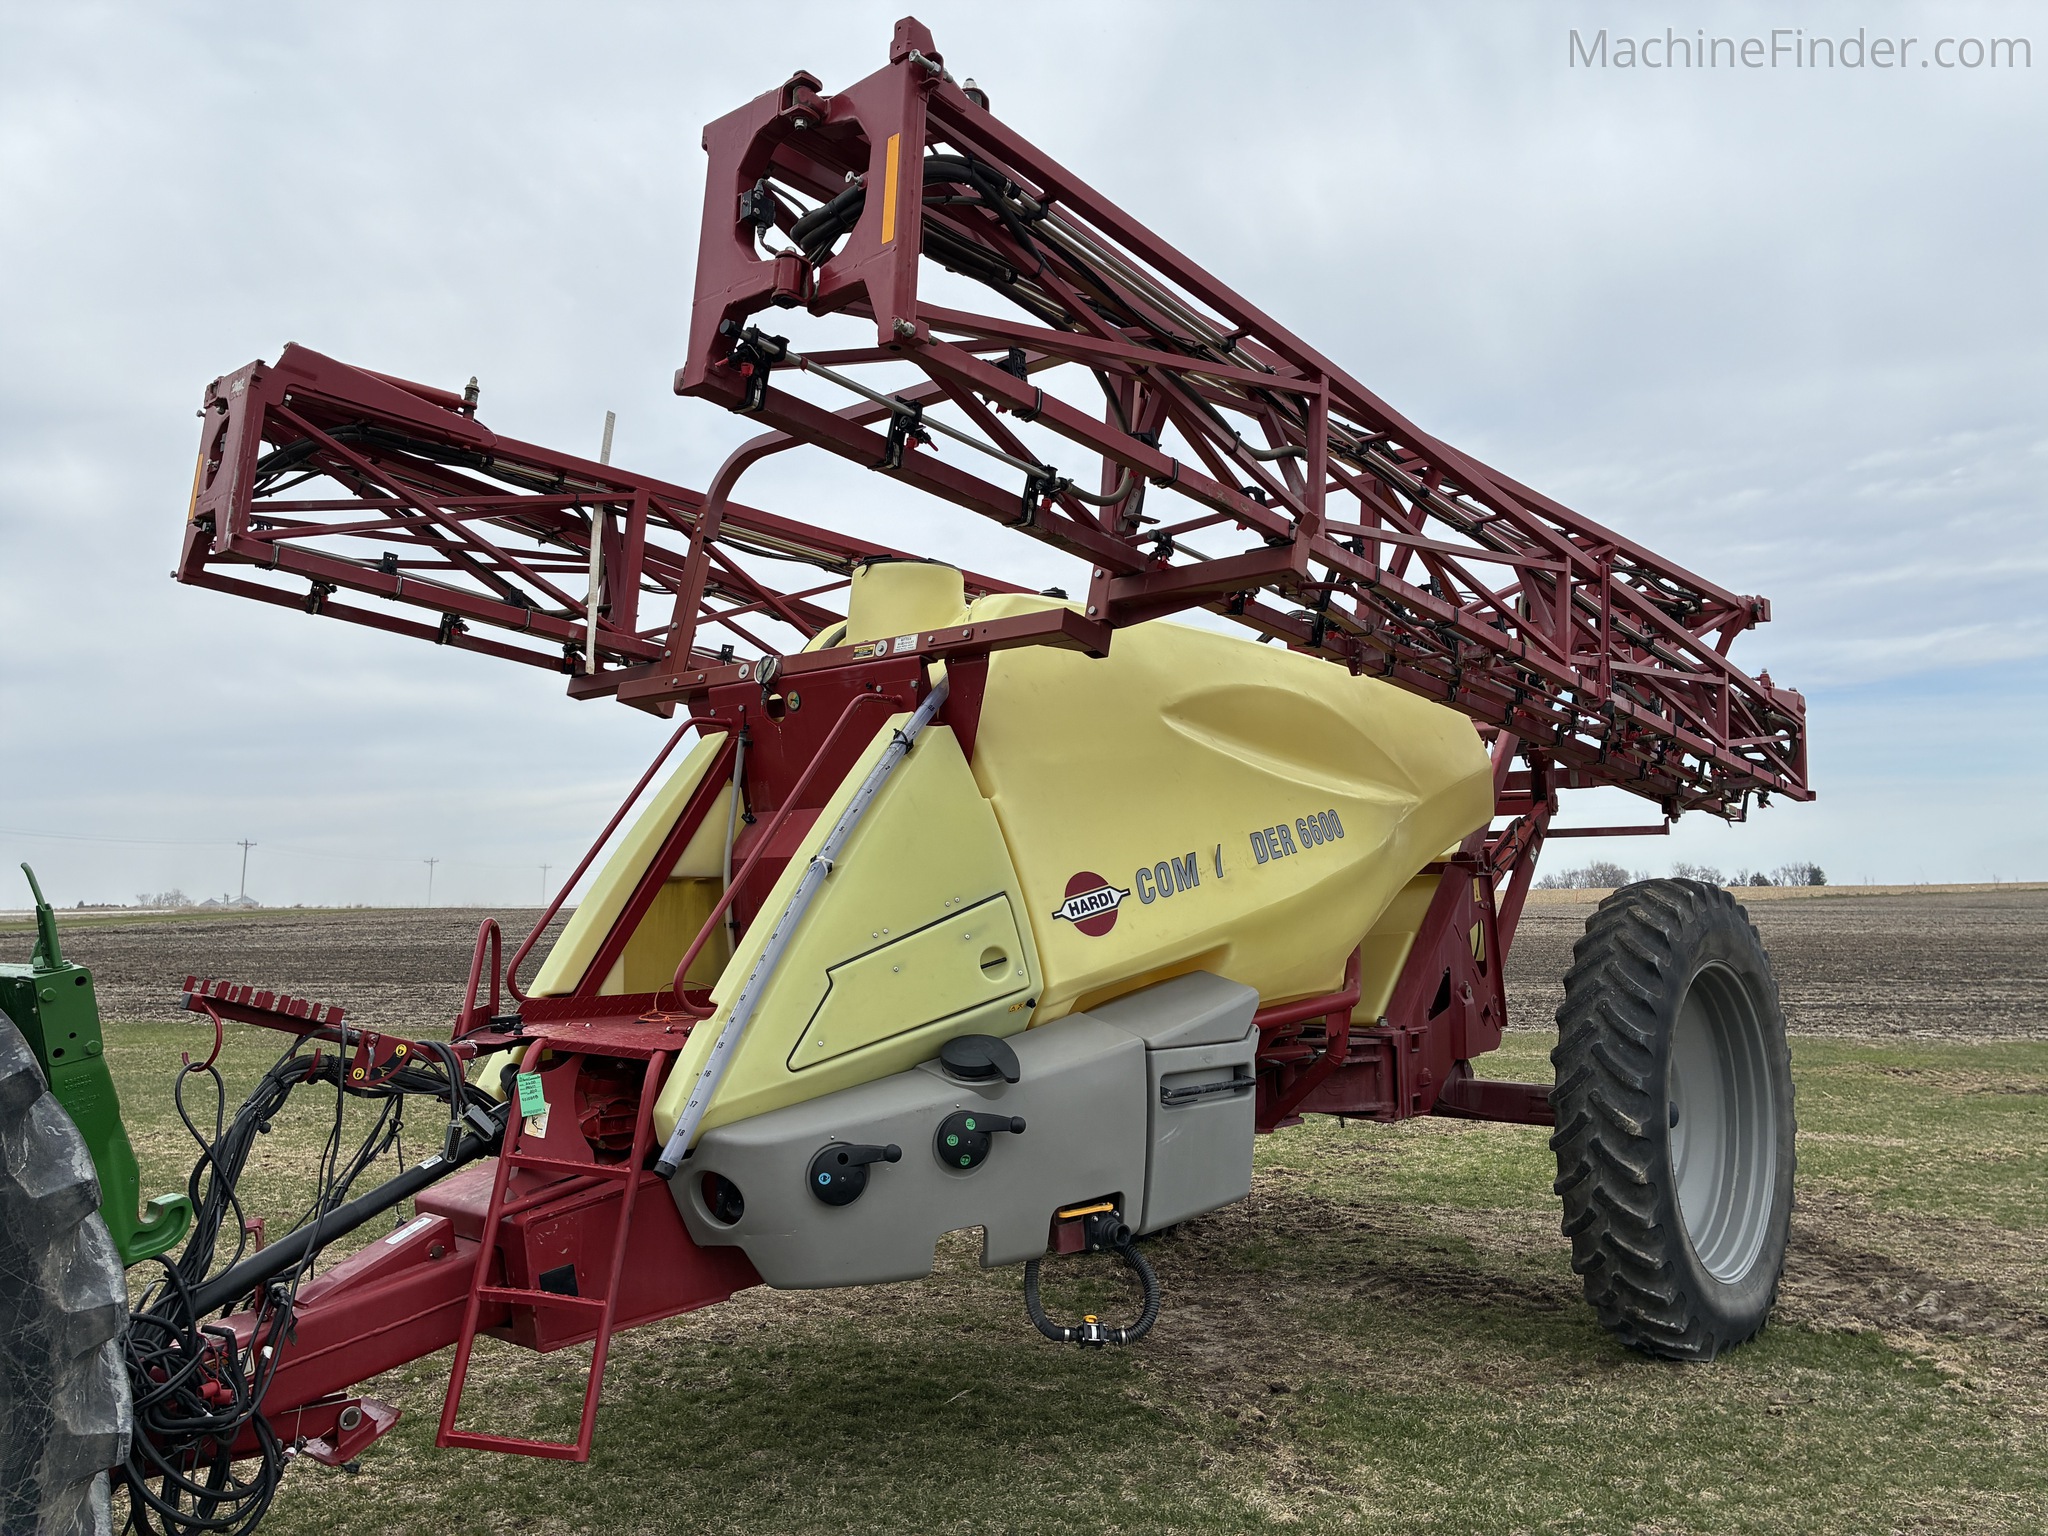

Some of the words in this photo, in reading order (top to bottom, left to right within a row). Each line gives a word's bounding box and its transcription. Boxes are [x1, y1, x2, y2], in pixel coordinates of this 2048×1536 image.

[1295, 808, 1345, 849] 6600
[1067, 890, 1115, 917] HARDI
[703, 1069, 712, 1078] 16
[689, 1100, 699, 1108] 17
[676, 1128, 686, 1137] 18
